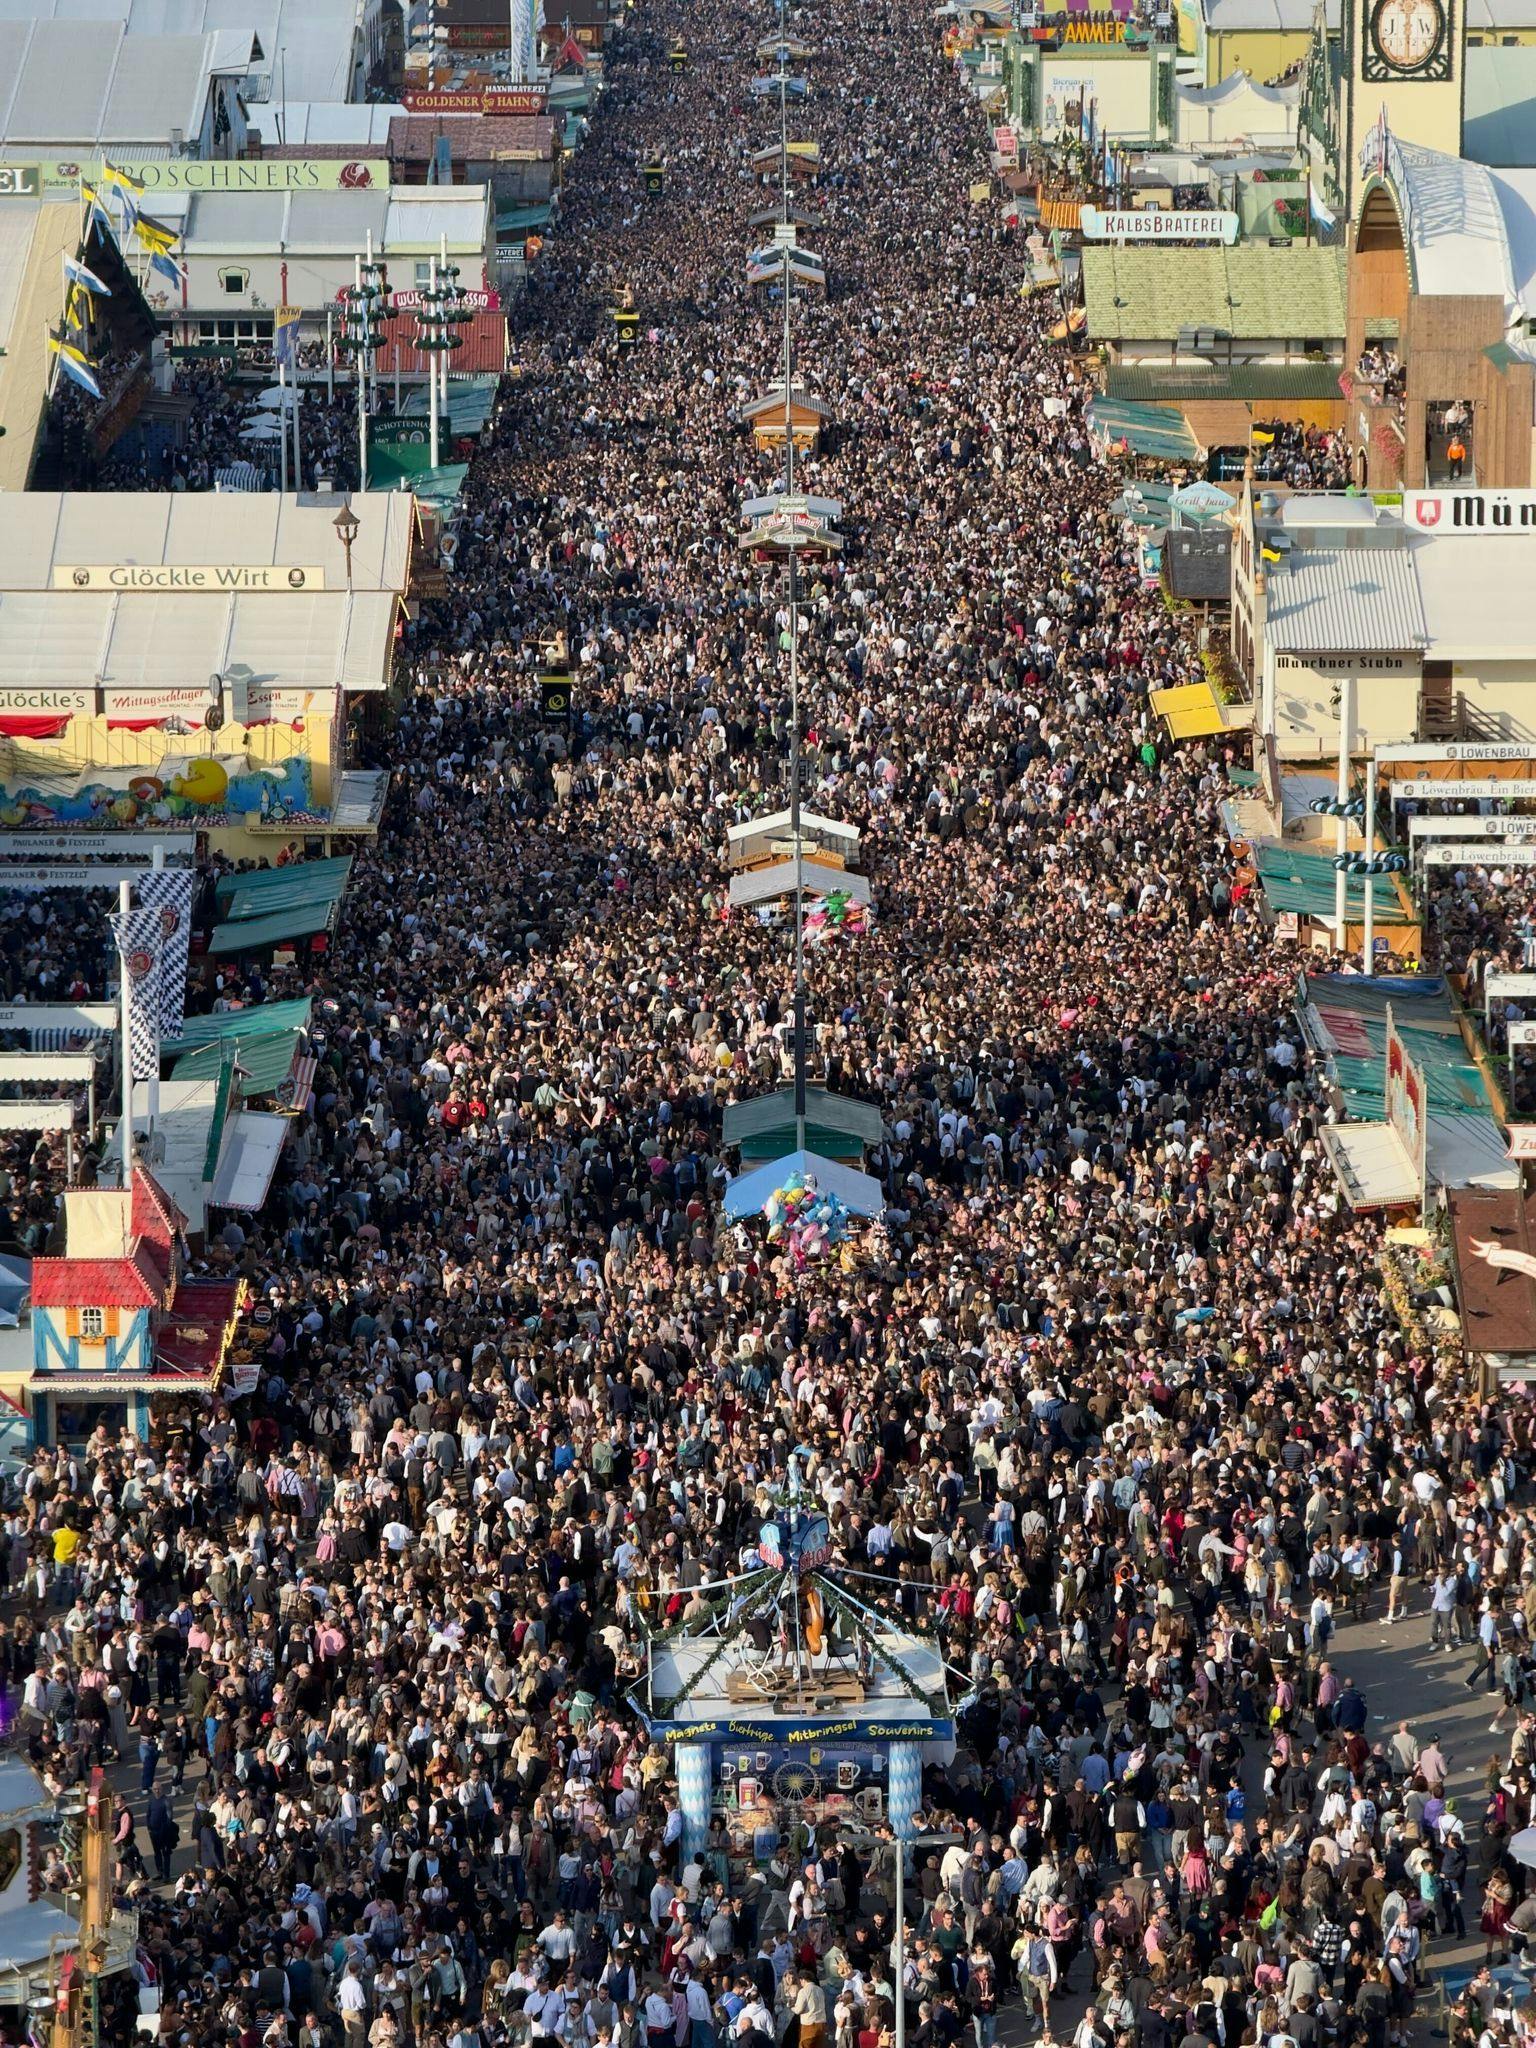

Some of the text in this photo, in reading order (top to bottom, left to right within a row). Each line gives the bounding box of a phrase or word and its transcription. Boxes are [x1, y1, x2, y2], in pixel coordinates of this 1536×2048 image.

[1065, 22, 1125, 43] AMMER
[485, 85, 546, 93] HAXNBRATEREI
[416, 96, 530, 107] GOLDENER HAHN
[1105, 216, 1223, 233] KALBSBRATEREI
[279, 308, 300, 316] ATM
[1453, 496, 1536, 526] Mün
[109, 567, 269, 587] Glöckle Wirt
[1360, 656, 1403, 669] Stubn
[247, 691, 281, 705] Essen
[1490, 784, 1509, 794] Ein
[1513, 783, 1536, 794] Bier
[665, 1722, 716, 1741] Magnete
[788, 1719, 857, 1743] Mitbringsel
[868, 1724, 933, 1737] Souvenirs
